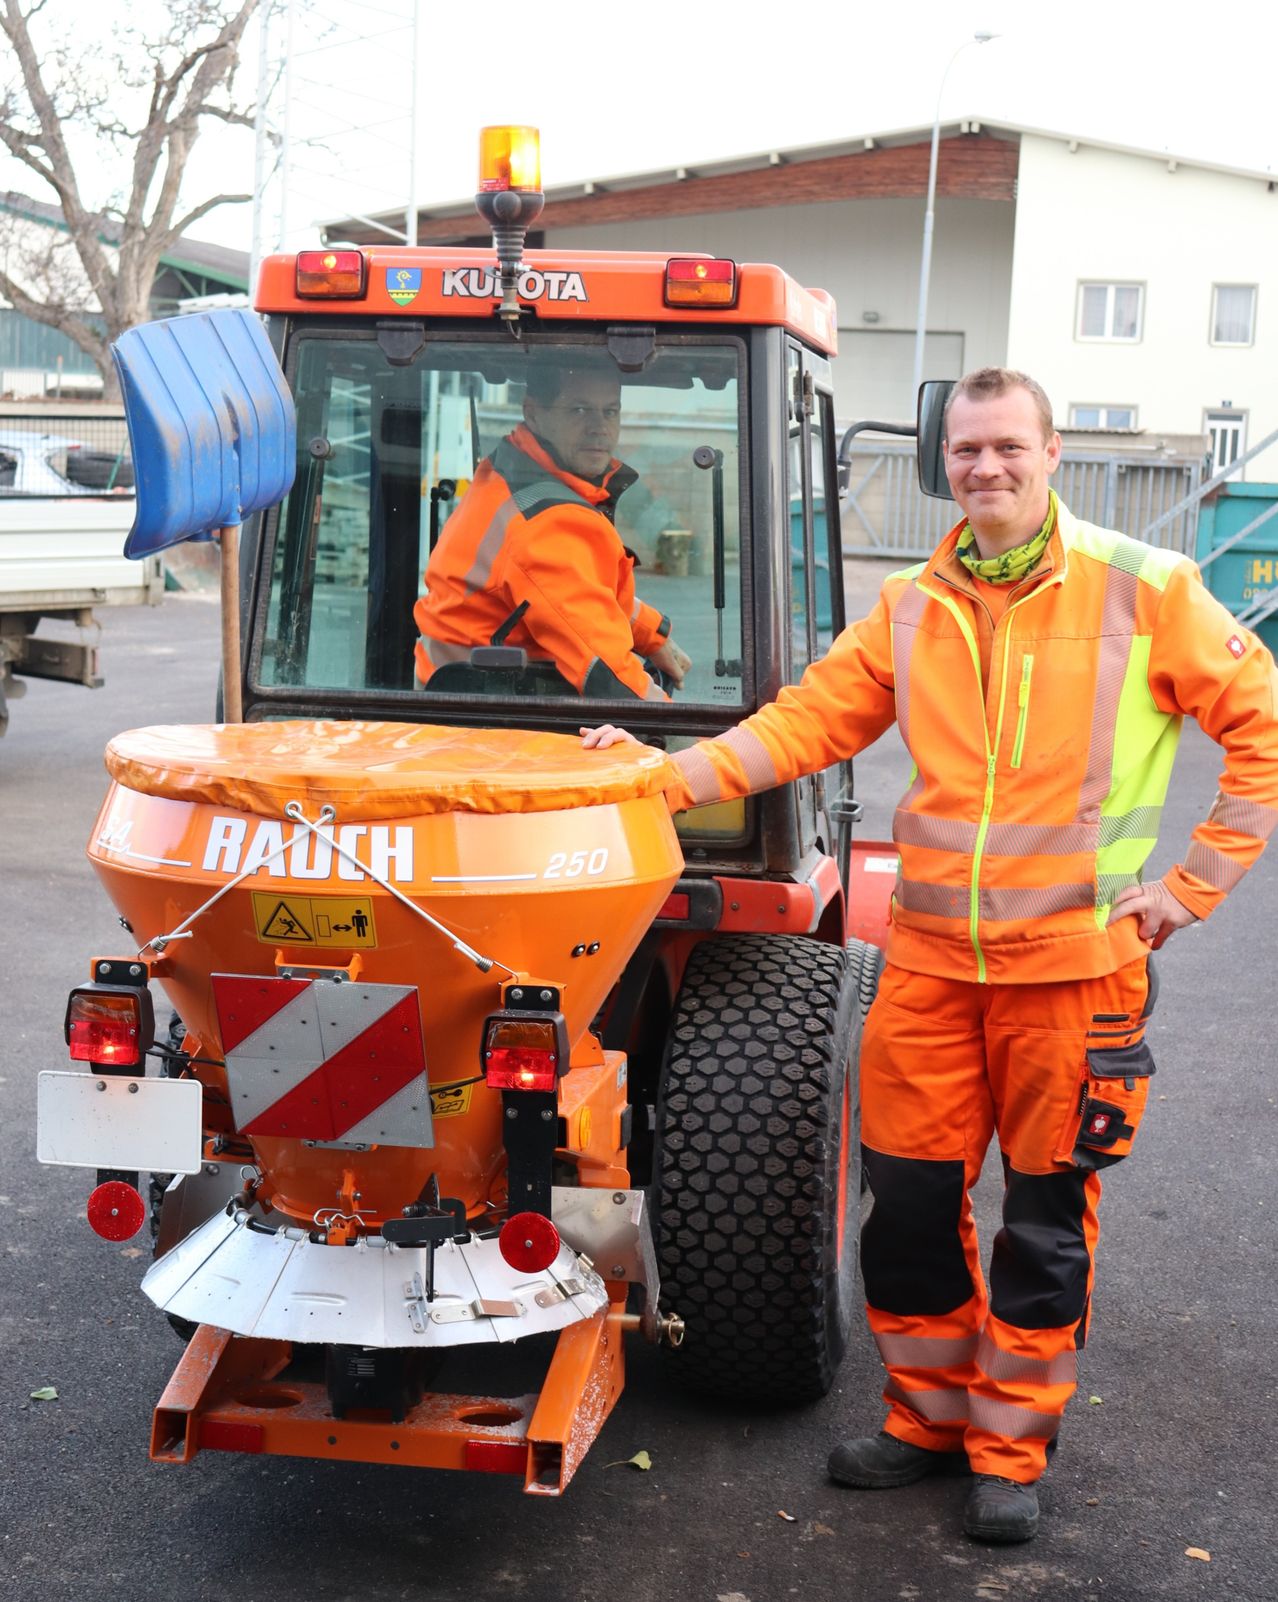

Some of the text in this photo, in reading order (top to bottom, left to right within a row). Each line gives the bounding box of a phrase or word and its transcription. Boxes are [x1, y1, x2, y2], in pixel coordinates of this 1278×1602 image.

[1252, 559, 1278, 584] H
[202, 815, 414, 882] RAUCH
[543, 847, 609, 879] 250
